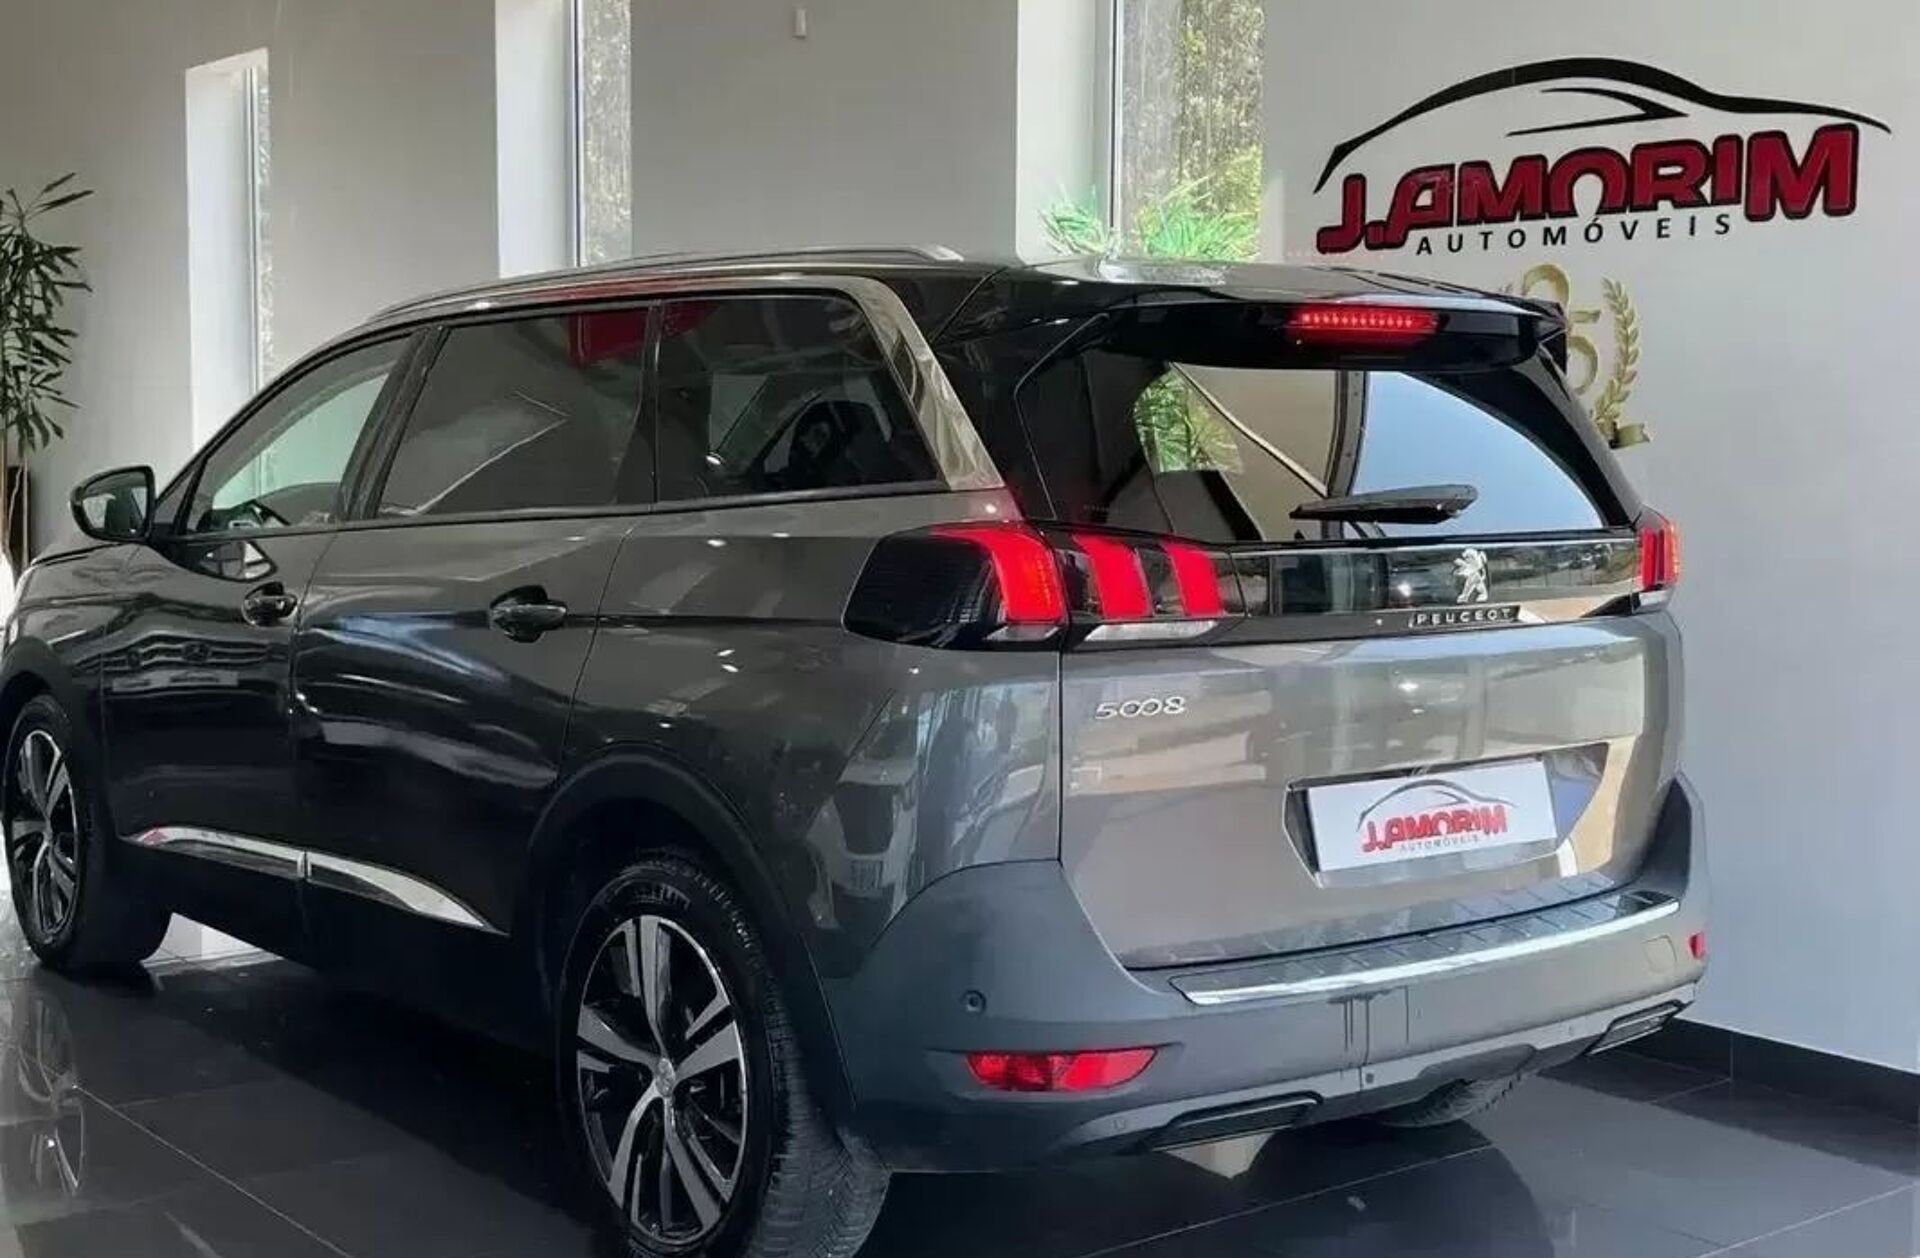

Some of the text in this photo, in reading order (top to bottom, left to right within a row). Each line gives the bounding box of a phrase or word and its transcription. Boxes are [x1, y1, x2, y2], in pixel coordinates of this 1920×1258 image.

[1316, 122, 1860, 254] J.AMORIM
[1416, 212, 1732, 256] AUTOMÓVEIS
[1416, 608, 1511, 625] PEUGEOT
[1094, 696, 1185, 720] 5008
